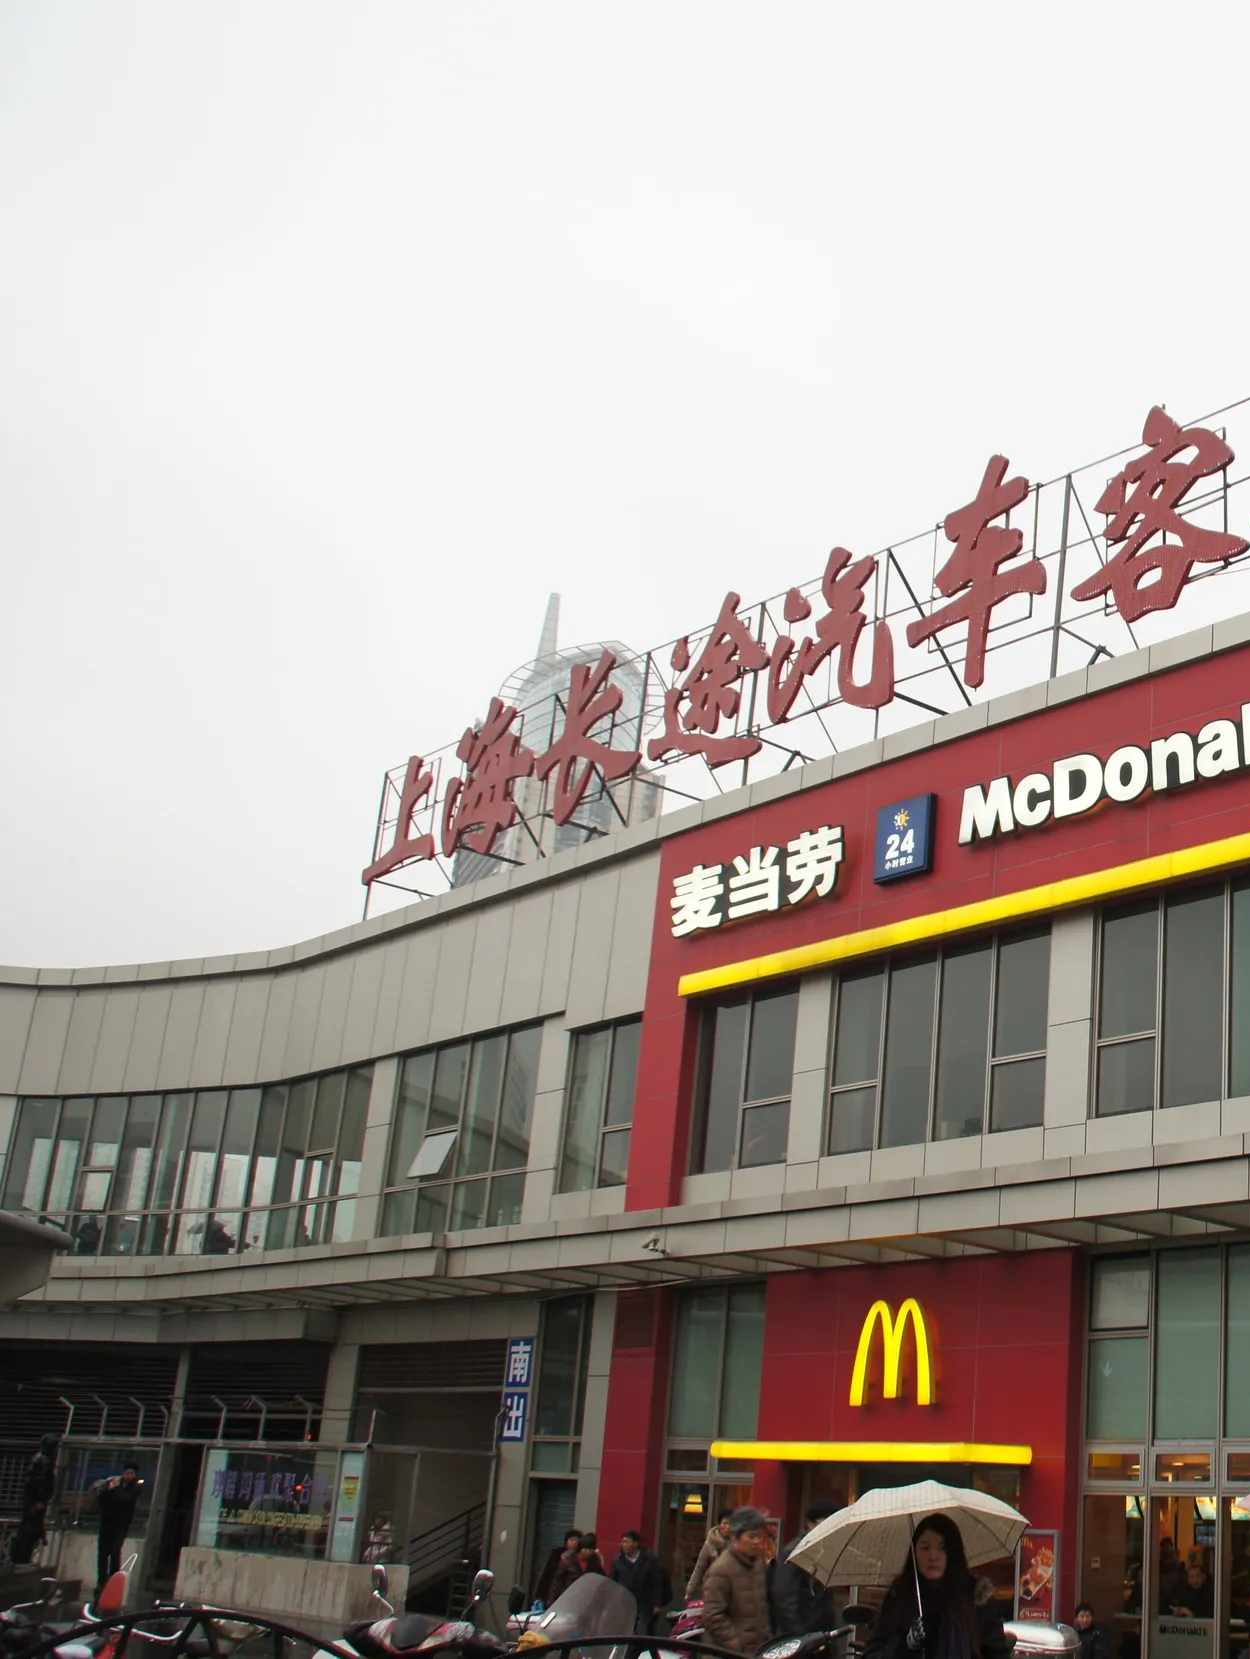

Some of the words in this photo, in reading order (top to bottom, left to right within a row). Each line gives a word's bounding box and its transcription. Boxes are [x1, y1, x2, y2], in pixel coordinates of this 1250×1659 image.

[885, 828, 915, 861] 24
[669, 825, 845, 939] 麦当劳
[1159, 1625, 1208, 1637] McDonald's
